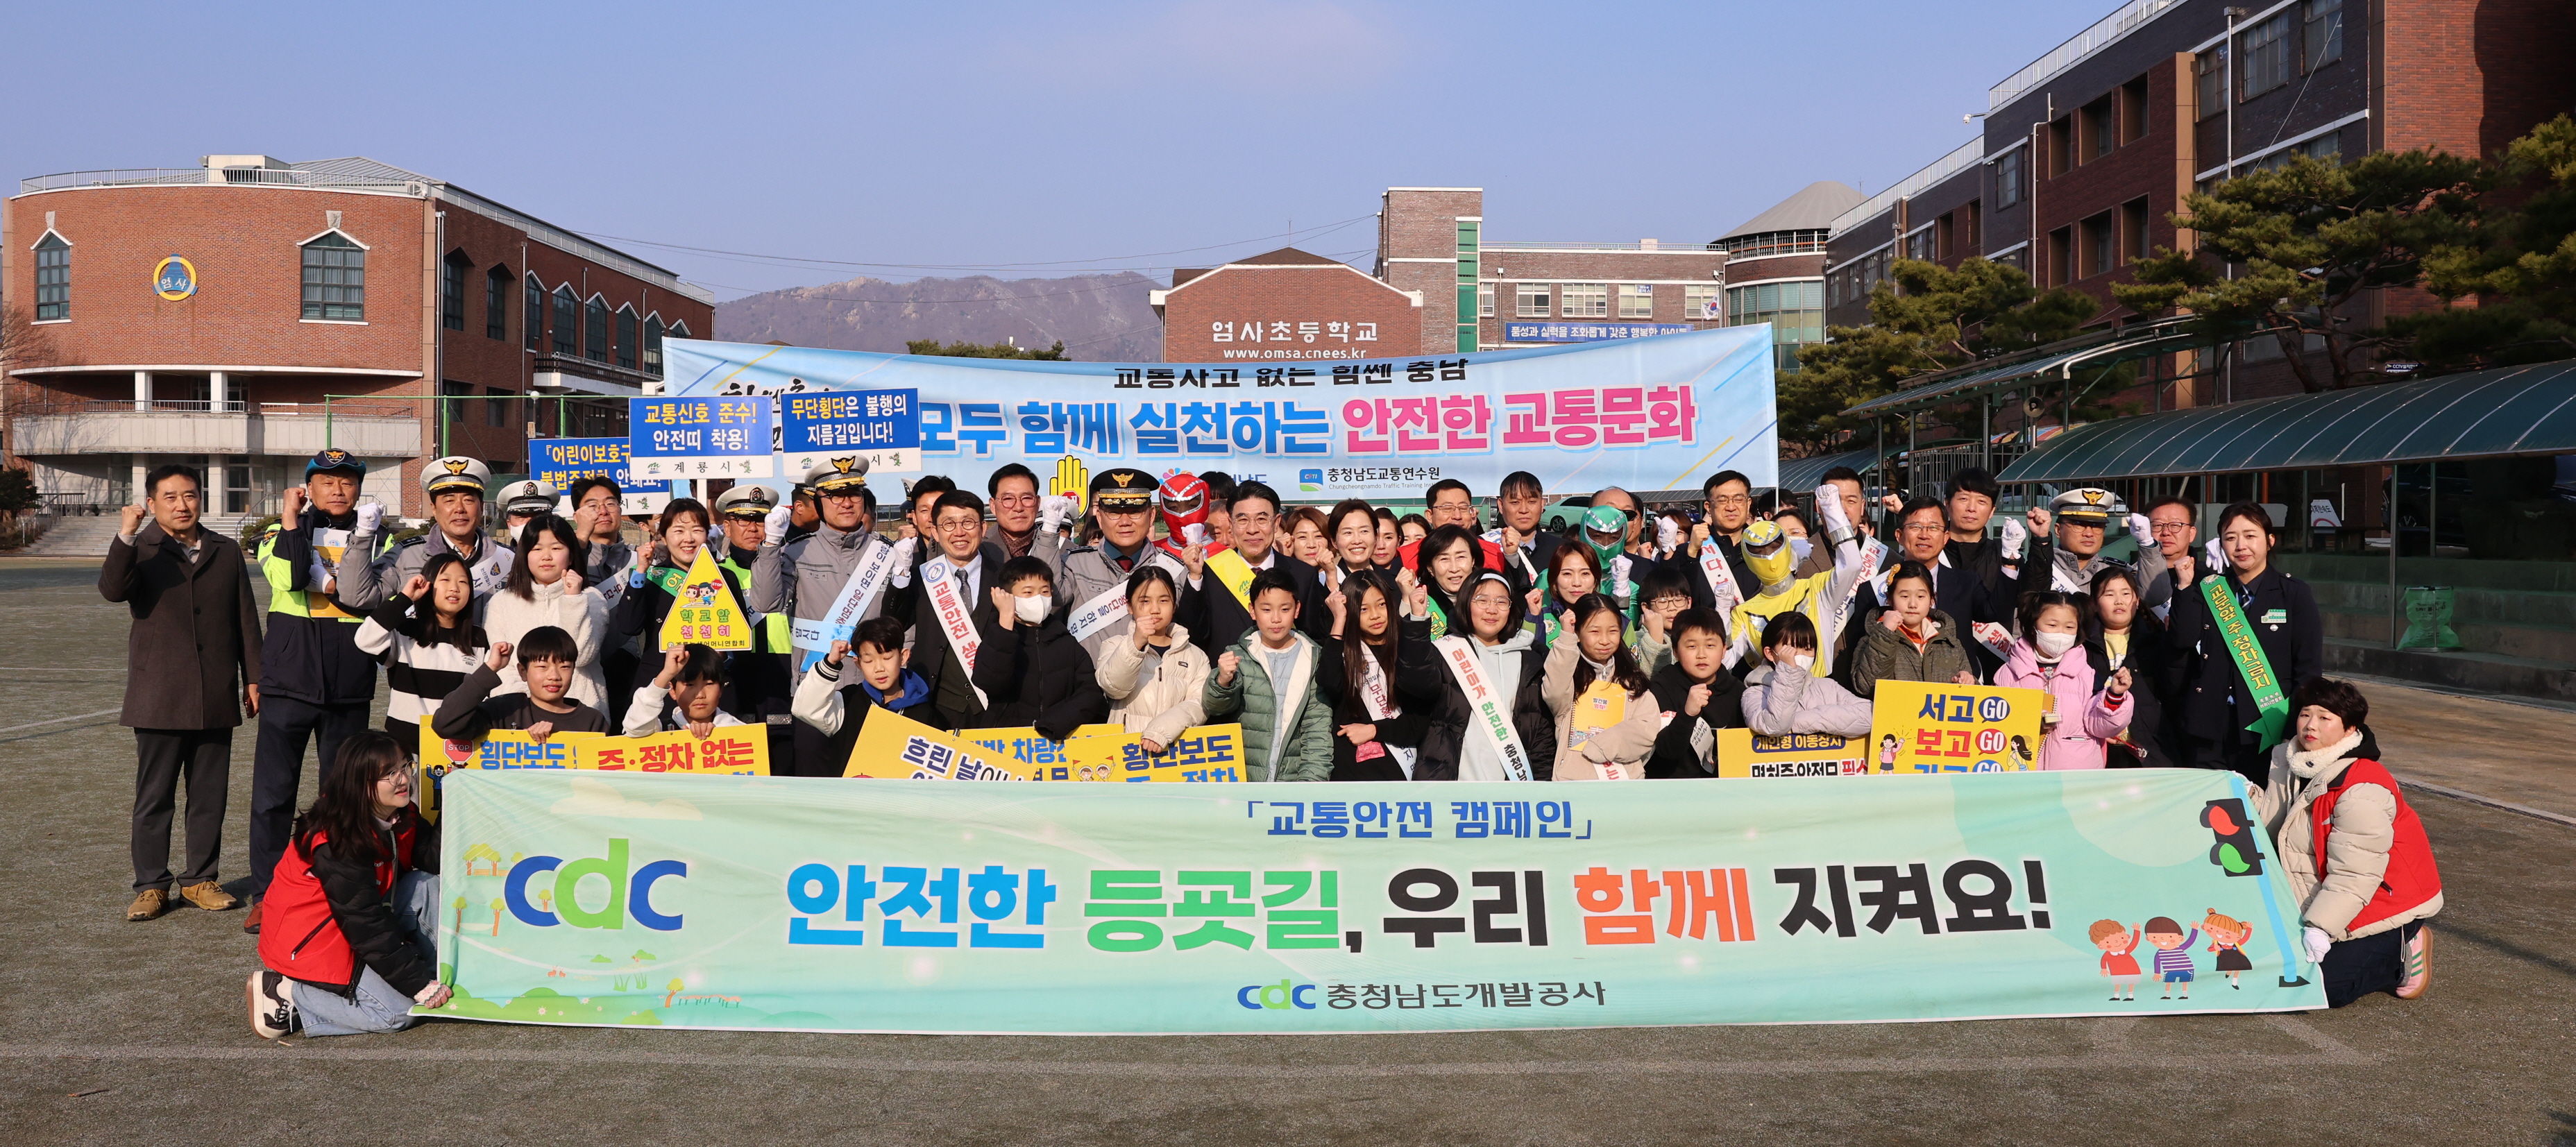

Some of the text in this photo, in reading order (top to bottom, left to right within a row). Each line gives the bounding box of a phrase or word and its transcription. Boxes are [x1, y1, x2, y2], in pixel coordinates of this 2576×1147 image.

[161, 278, 187, 290] 엄사
[1212, 321, 1378, 343] 엄사초등학교
[1511, 326, 1539, 337] 품성과
[1541, 326, 1568, 338] 실력을
[1570, 327, 1607, 338] 조화롭게
[1609, 328, 1628, 338] 갖춘
[1223, 347, 1366, 359] www.omsa.cnees.kr
[1114, 358, 1468, 389] 교통사고 없는 힘쎈 충남
[645, 402, 757, 425] 교통신호 준수!
[791, 393, 907, 420] 무단횡단은 불행의
[920, 384, 1697, 454] 모두 함께 실천하는 안전한 교통문화
[653, 429, 701, 451] 안전띠
[711, 428, 749, 451] 착용!
[807, 421, 894, 446] 지름길입니다!
[1327, 467, 1440, 482] 충청남도교통연수원
[933, 580, 970, 640] 교통안전
[2210, 584, 2237, 623] 교문앞
[1452, 648, 1486, 699] 어린이가
[1481, 701, 1509, 742] 안전한
[1918, 693, 2008, 723] 서고 GO
[448, 743, 470, 752] STOP
[479, 740, 566, 770] 횡단보도
[700, 738, 754, 767] 없는
[903, 738, 953, 774] 흐린
[1915, 728, 2005, 758] 보고 GO
[504, 838, 688, 931] cdc
[787, 859, 2052, 953] 안전한 등굣길, 우리 함께 지켜요!
[1237, 978, 1607, 1011] cdc 충청남도개발공사
